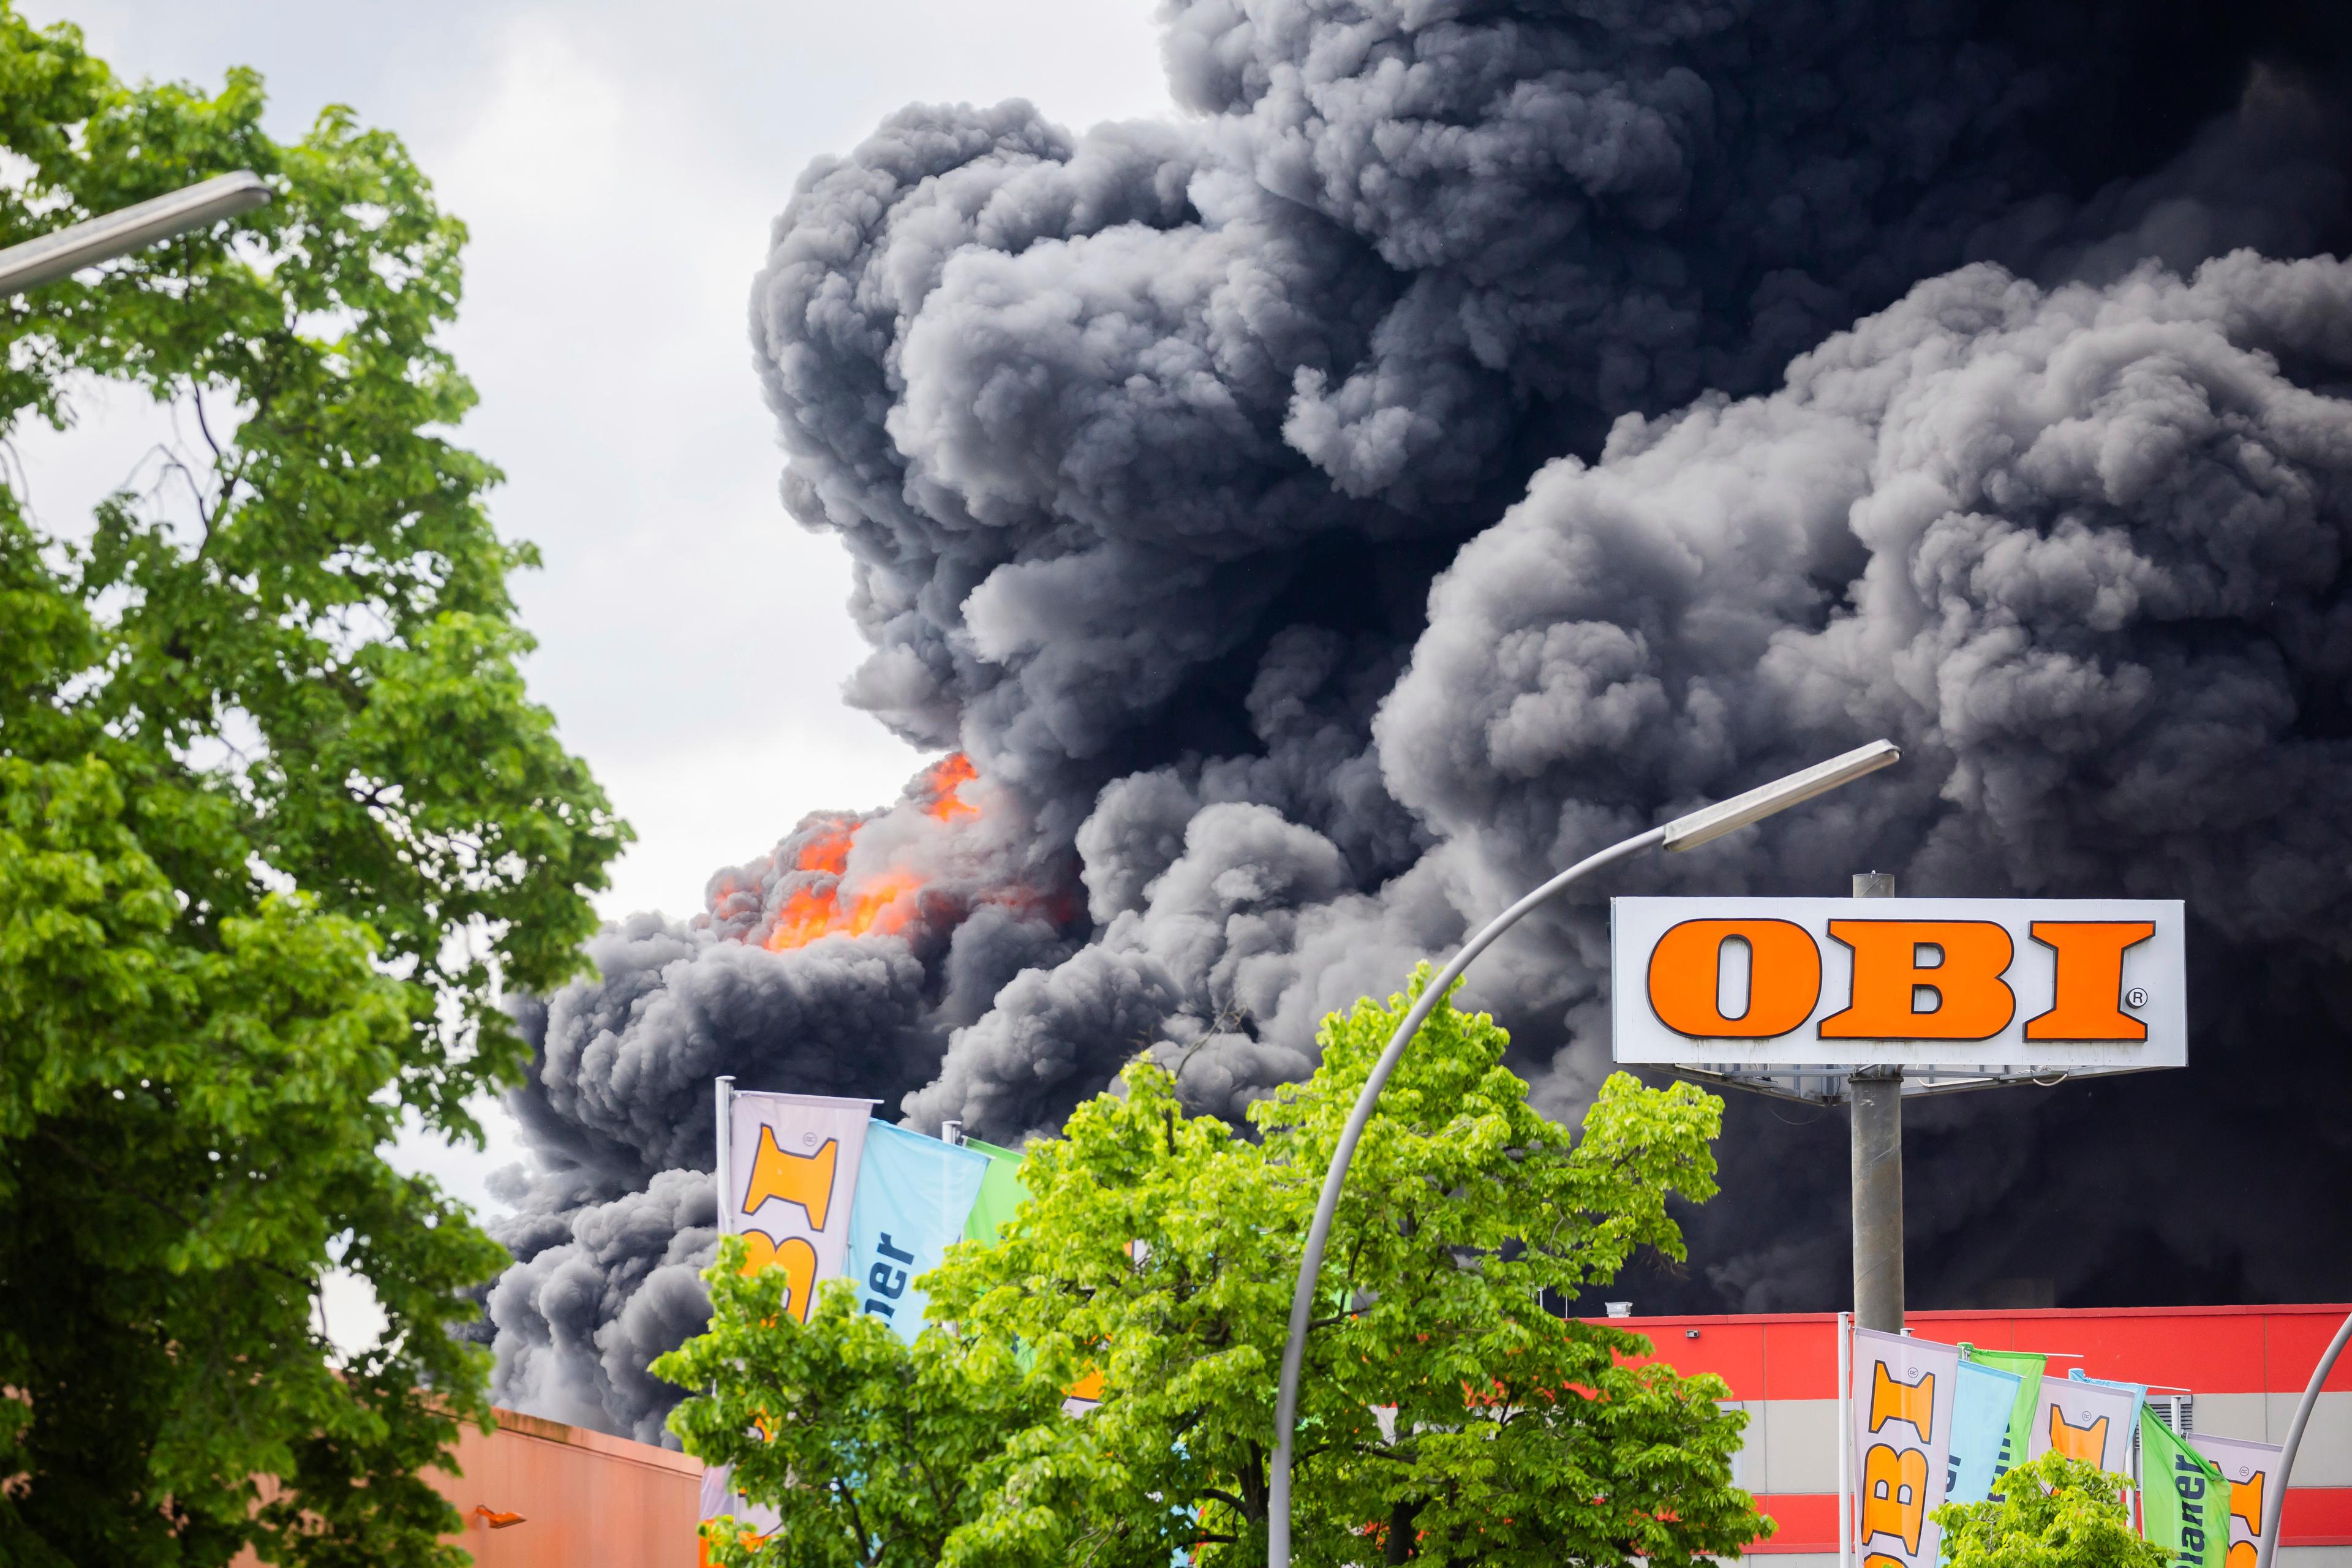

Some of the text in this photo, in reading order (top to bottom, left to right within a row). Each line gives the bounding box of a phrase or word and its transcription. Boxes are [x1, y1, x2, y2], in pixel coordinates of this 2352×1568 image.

[1647, 917, 2157, 1043] OBI
[1861, 1359, 1936, 1568] BI
[2175, 1453, 2205, 1568] laner
